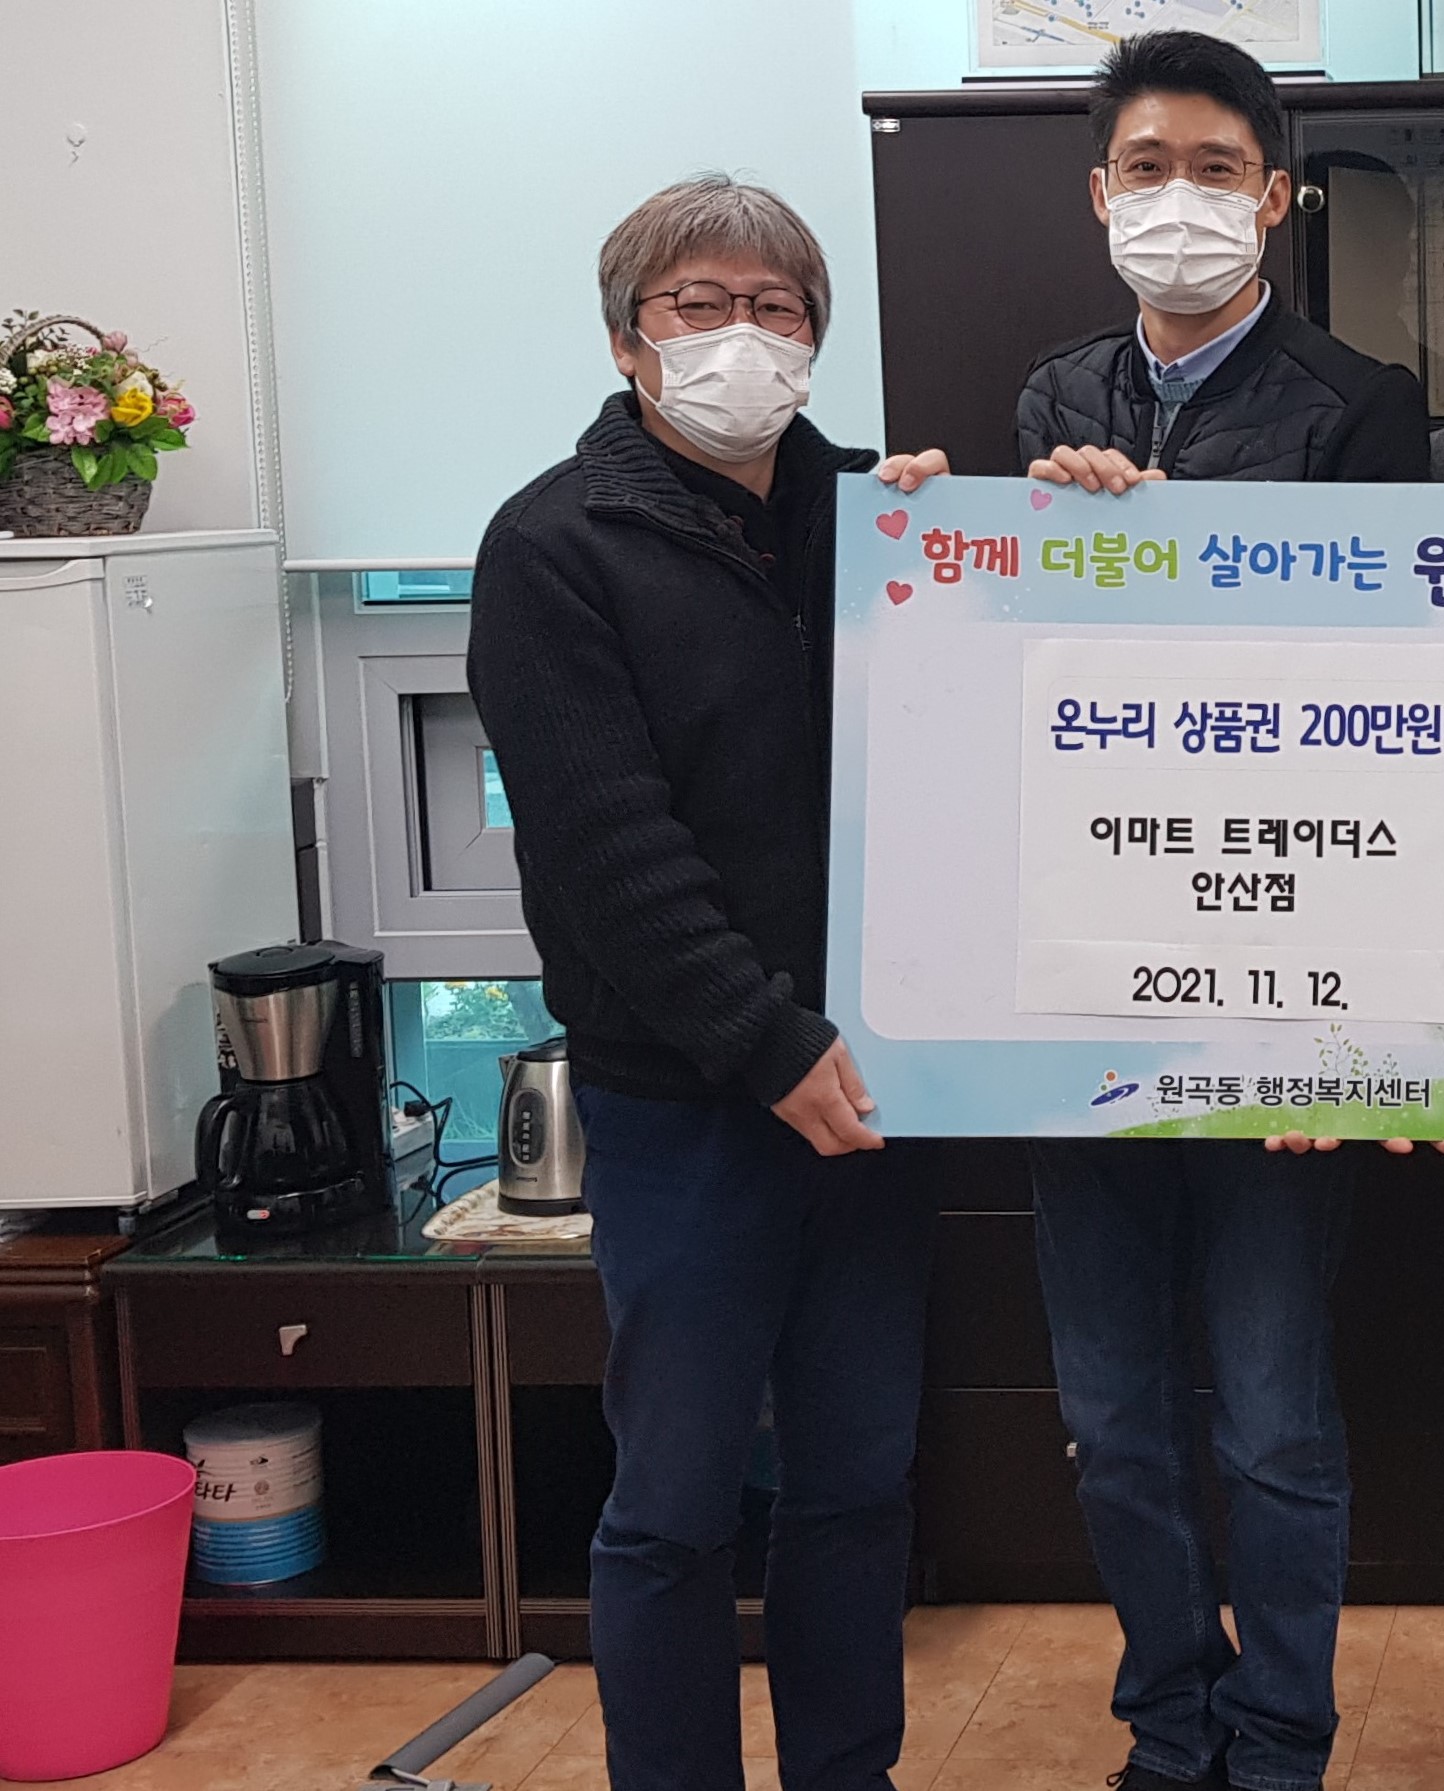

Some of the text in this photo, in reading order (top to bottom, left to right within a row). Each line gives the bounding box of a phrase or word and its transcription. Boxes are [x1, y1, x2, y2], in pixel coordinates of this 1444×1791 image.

[921, 529, 1019, 584] 함께
[1042, 533, 1177, 587] 더불어
[1199, 534, 1387, 591] 살아가는
[1051, 699, 1441, 755] 온누리 상품권 200만원
[1091, 817, 1396, 858] 이마트 트레이더스
[1192, 872, 1295, 912] 안산점
[1133, 966, 1347, 1010] 2021. 11. 12.
[1155, 1074, 1431, 1109] 원곡동 행정복지센터
